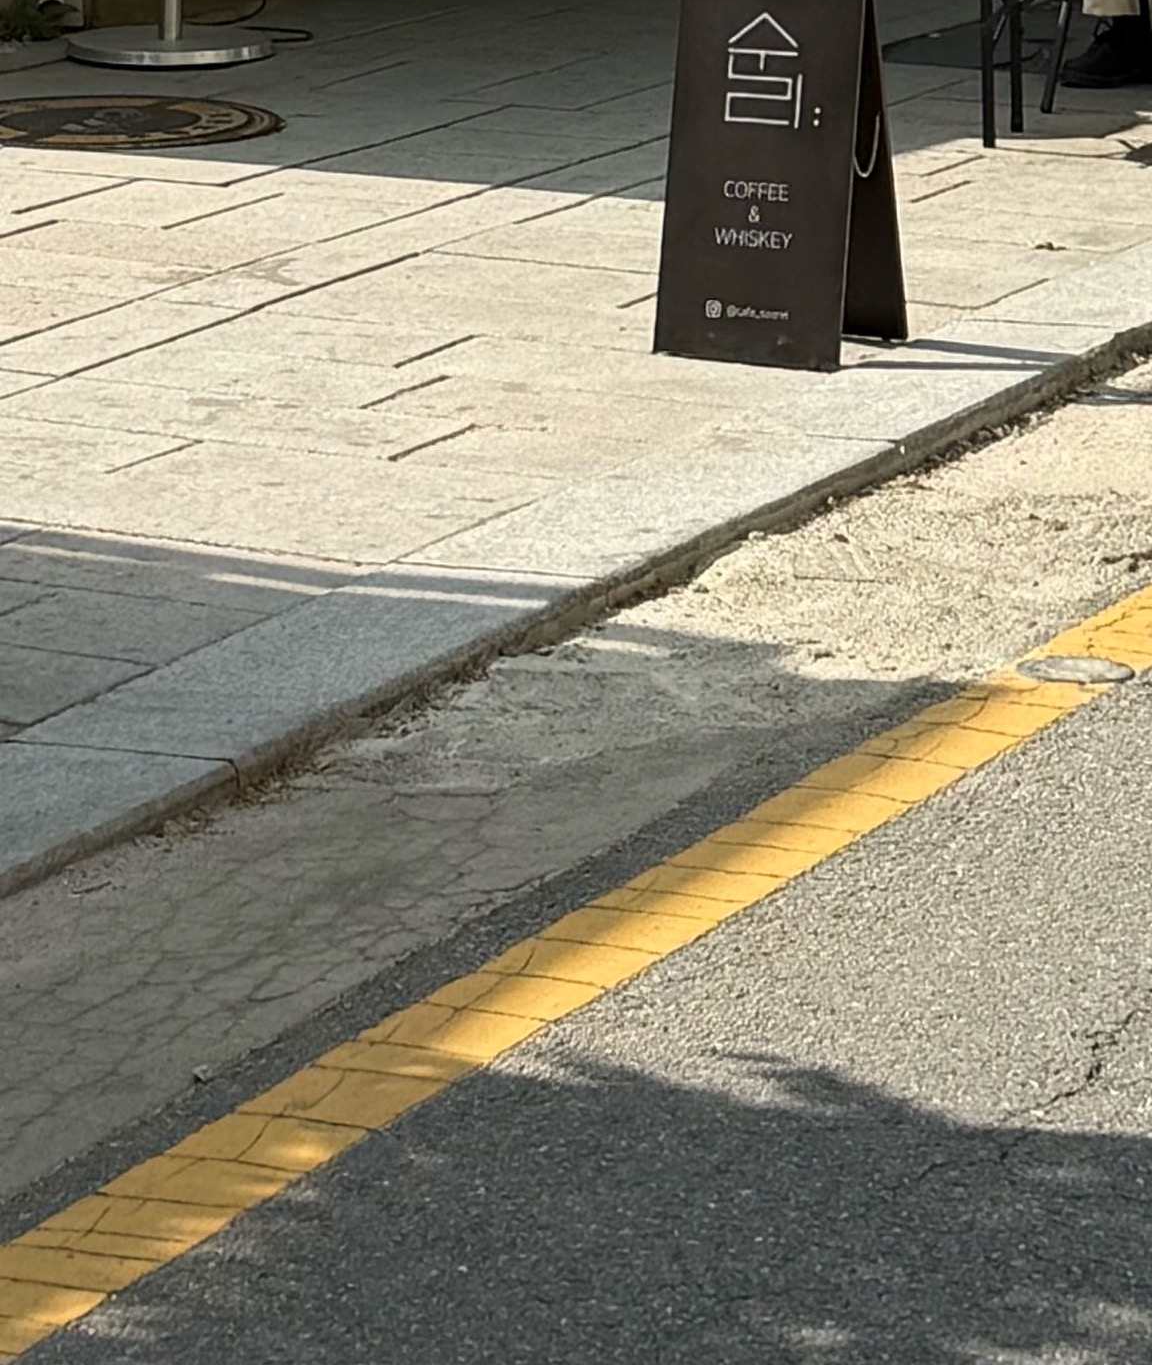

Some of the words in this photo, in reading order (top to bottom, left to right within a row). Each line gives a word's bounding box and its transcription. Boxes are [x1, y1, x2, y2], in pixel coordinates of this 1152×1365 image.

[723, 180, 789, 202] COFFEE
[747, 205, 760, 223] &
[714, 227, 793, 250] WHISKEY
